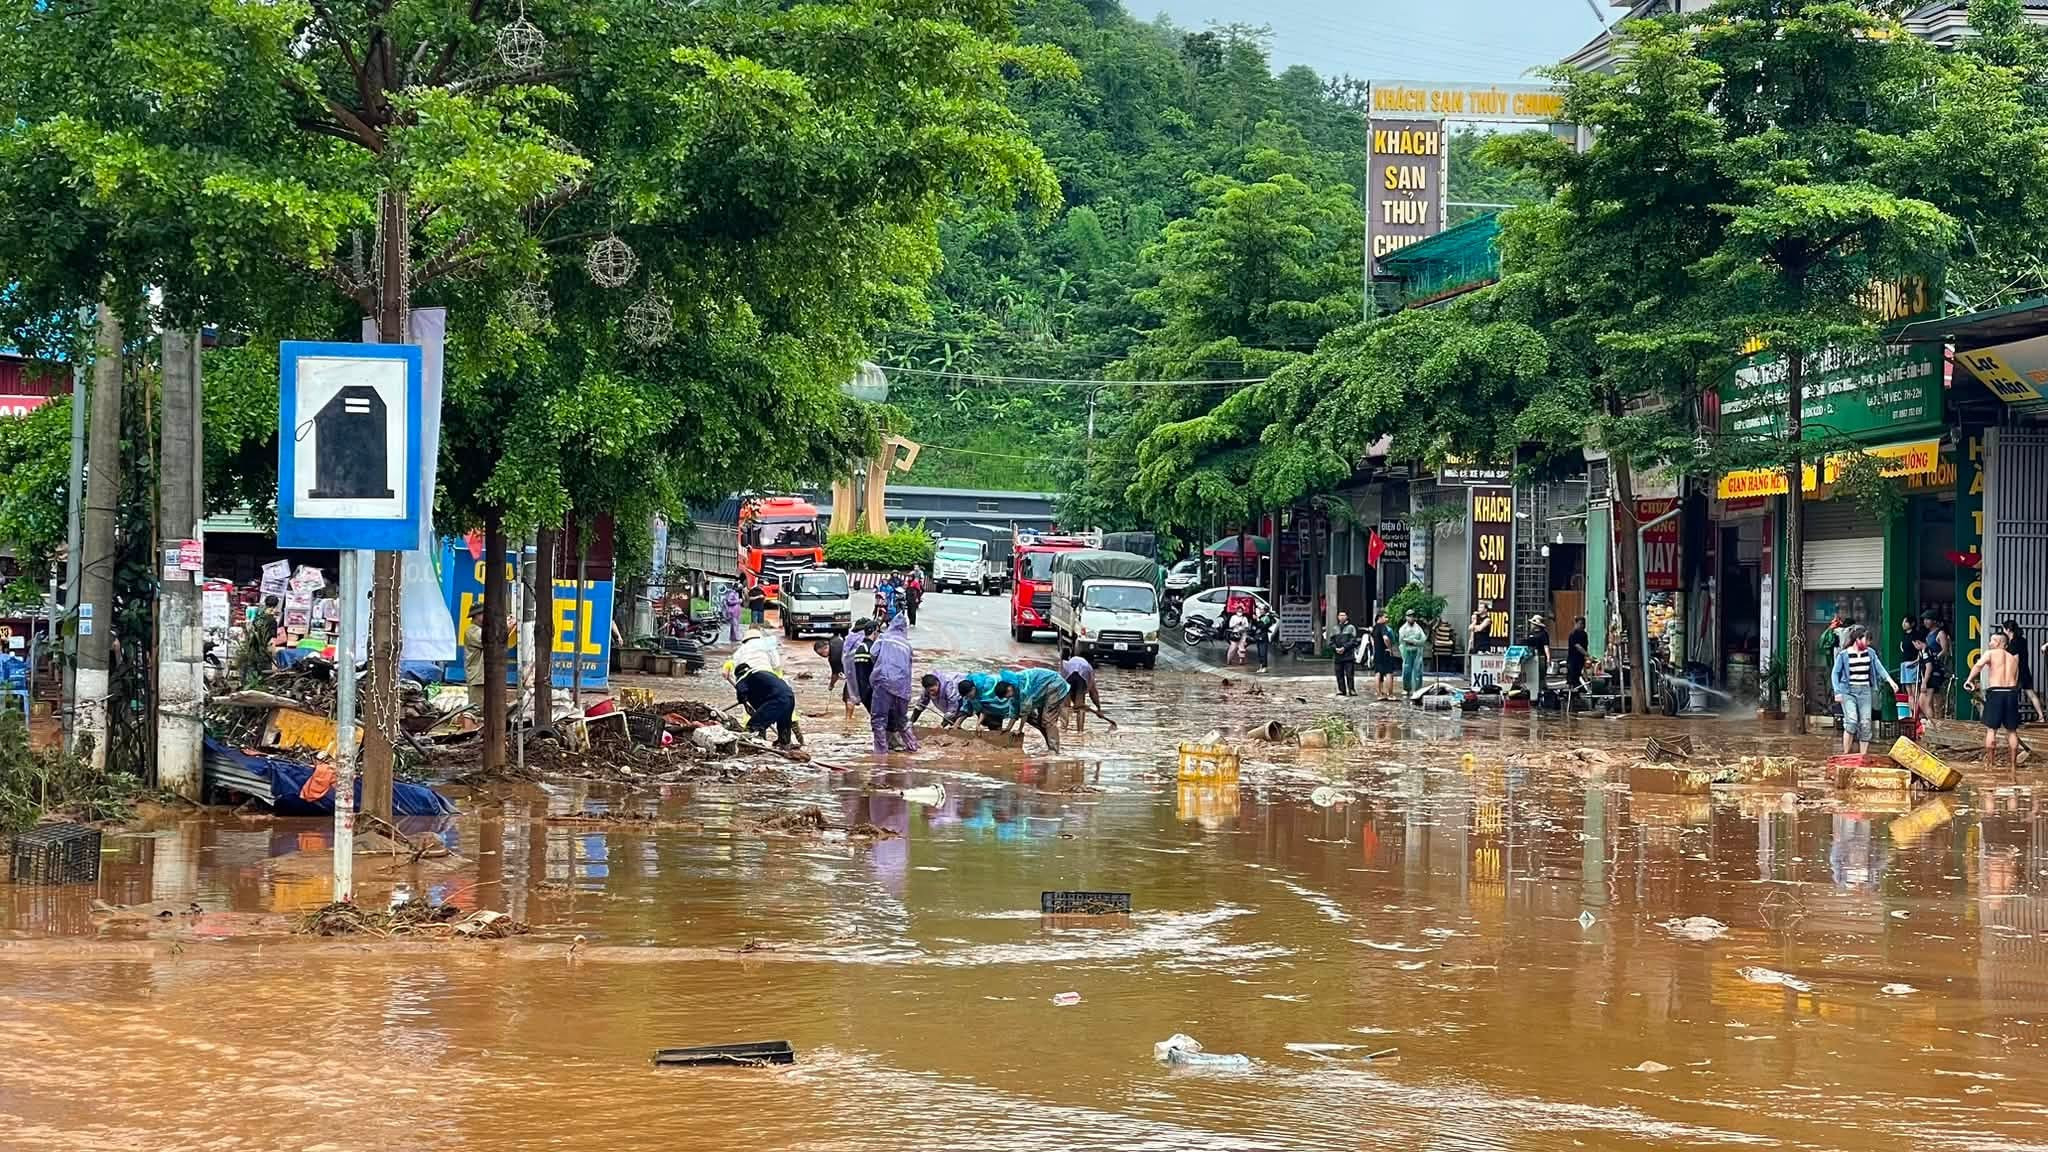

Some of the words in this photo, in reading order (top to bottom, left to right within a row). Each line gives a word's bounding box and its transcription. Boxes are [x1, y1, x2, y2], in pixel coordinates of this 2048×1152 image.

[1374, 86, 1426, 111] KHÁCH
[1374, 125, 1437, 155] KHÁCH
[1384, 165, 1426, 194] SẠN
[1382, 191, 1428, 224] THỦY
[1728, 477, 1746, 492] GIAN
[1474, 491, 1511, 522] KHÁCH
[1479, 535, 1505, 565] SẠN
[1476, 564, 1506, 599] THỦY
[1473, 670, 1493, 687] XÔI
